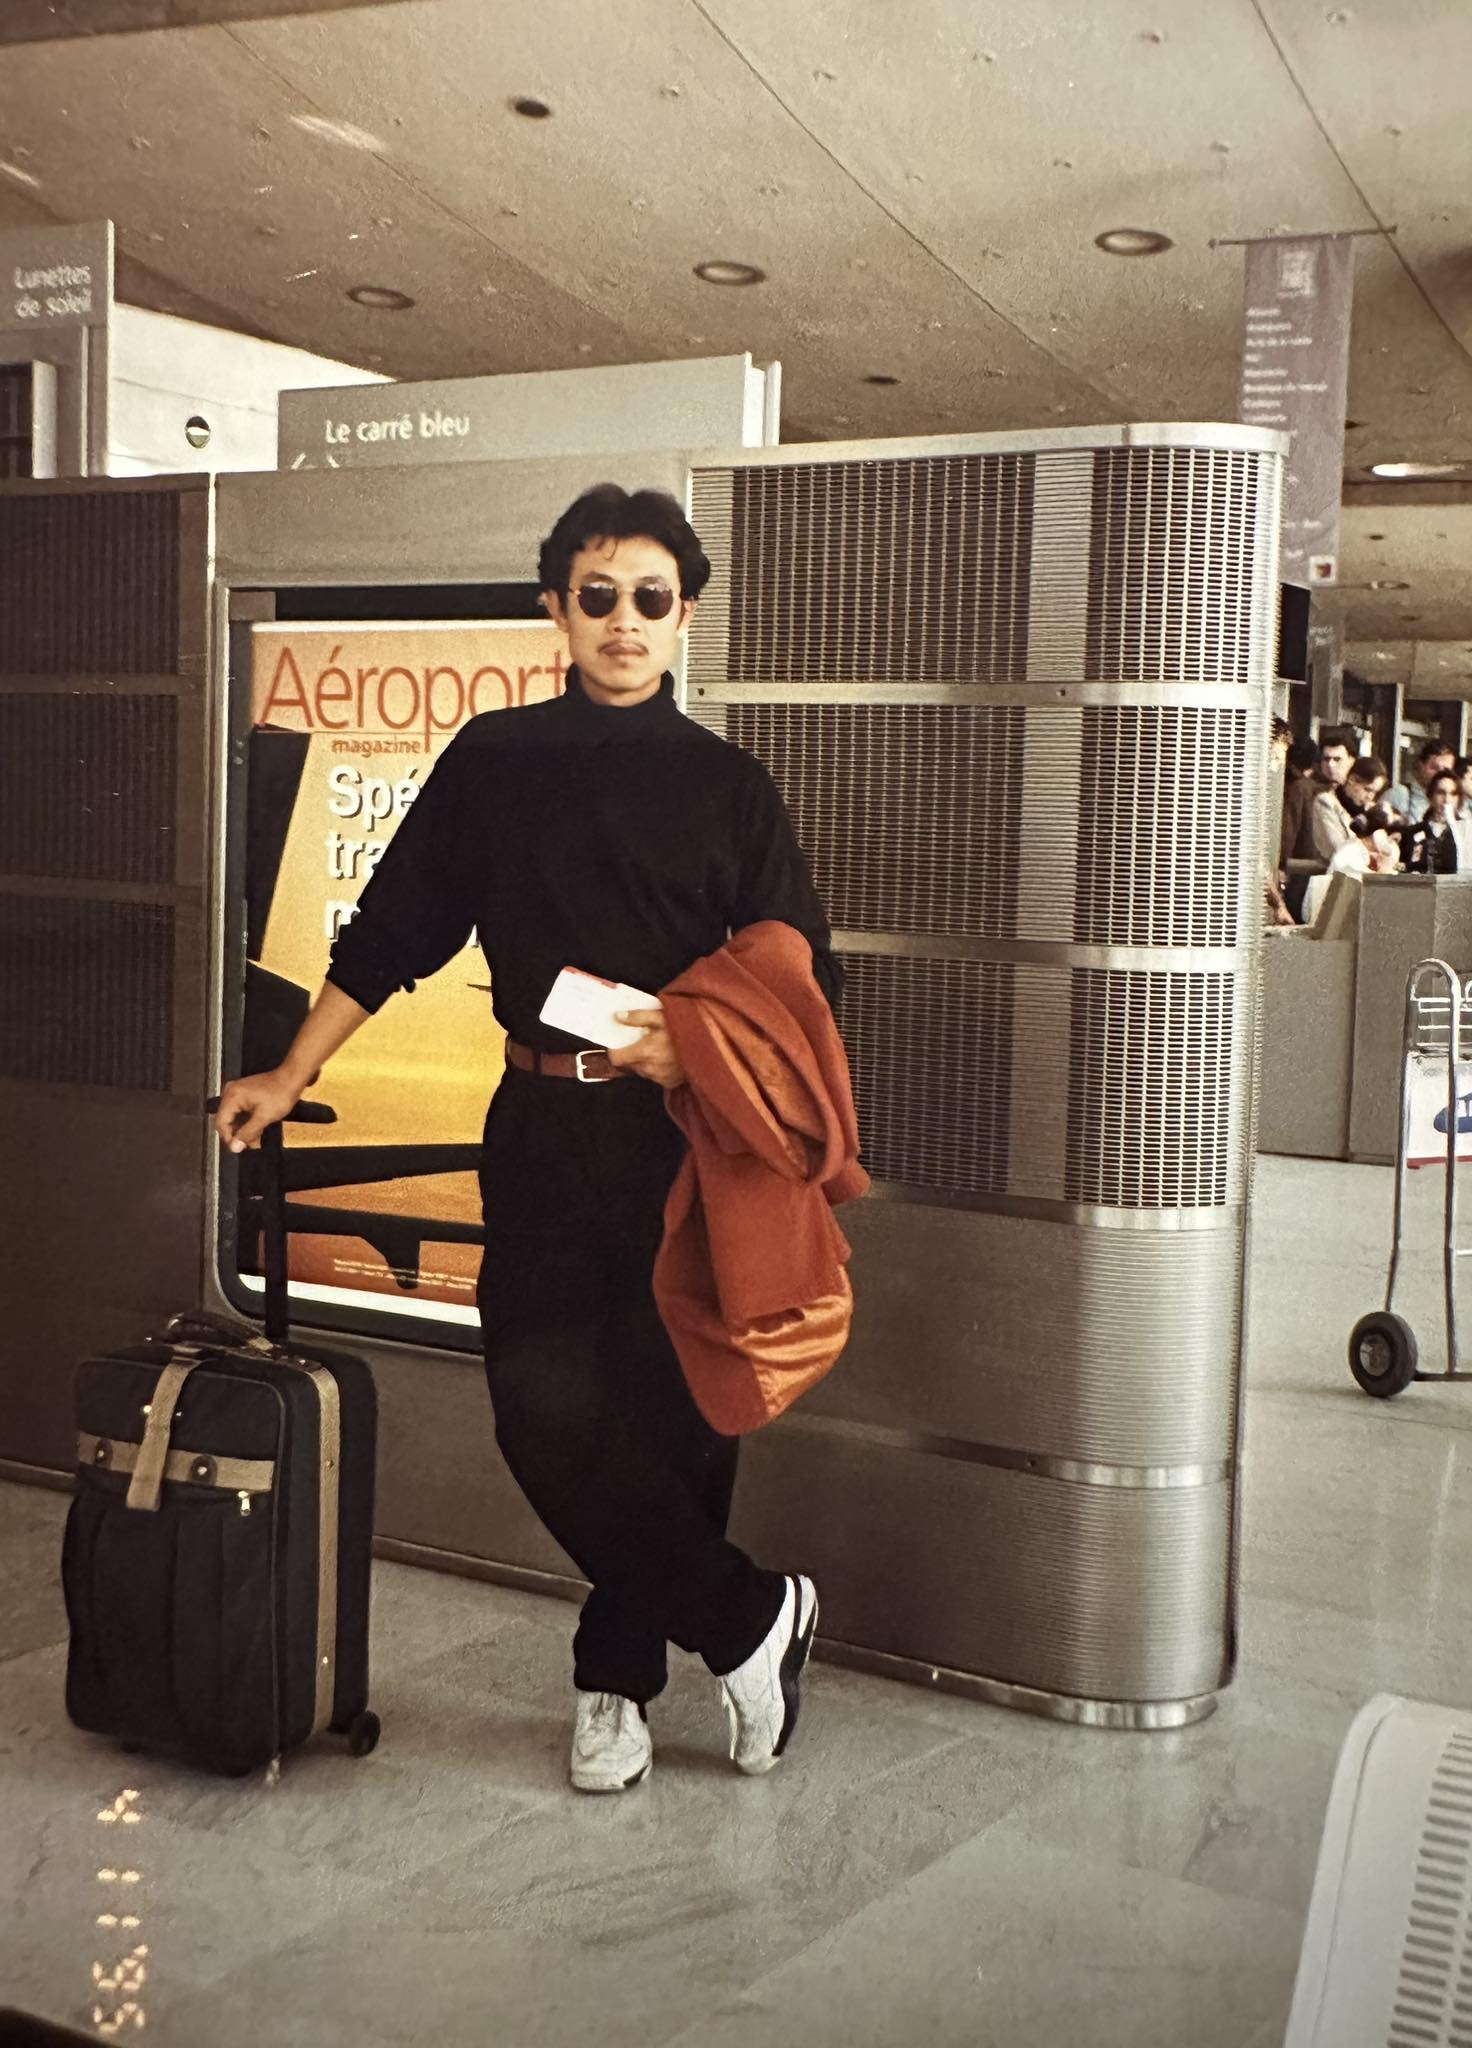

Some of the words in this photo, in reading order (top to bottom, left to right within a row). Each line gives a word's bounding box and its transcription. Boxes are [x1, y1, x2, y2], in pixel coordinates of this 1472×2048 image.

[15, 294, 41, 318] de
[325, 419, 352, 444] Le
[356, 414, 413, 442] carré
[419, 411, 470, 438] bleu
[259, 645, 567, 752] Aéroport
[331, 737, 421, 758] magazine
